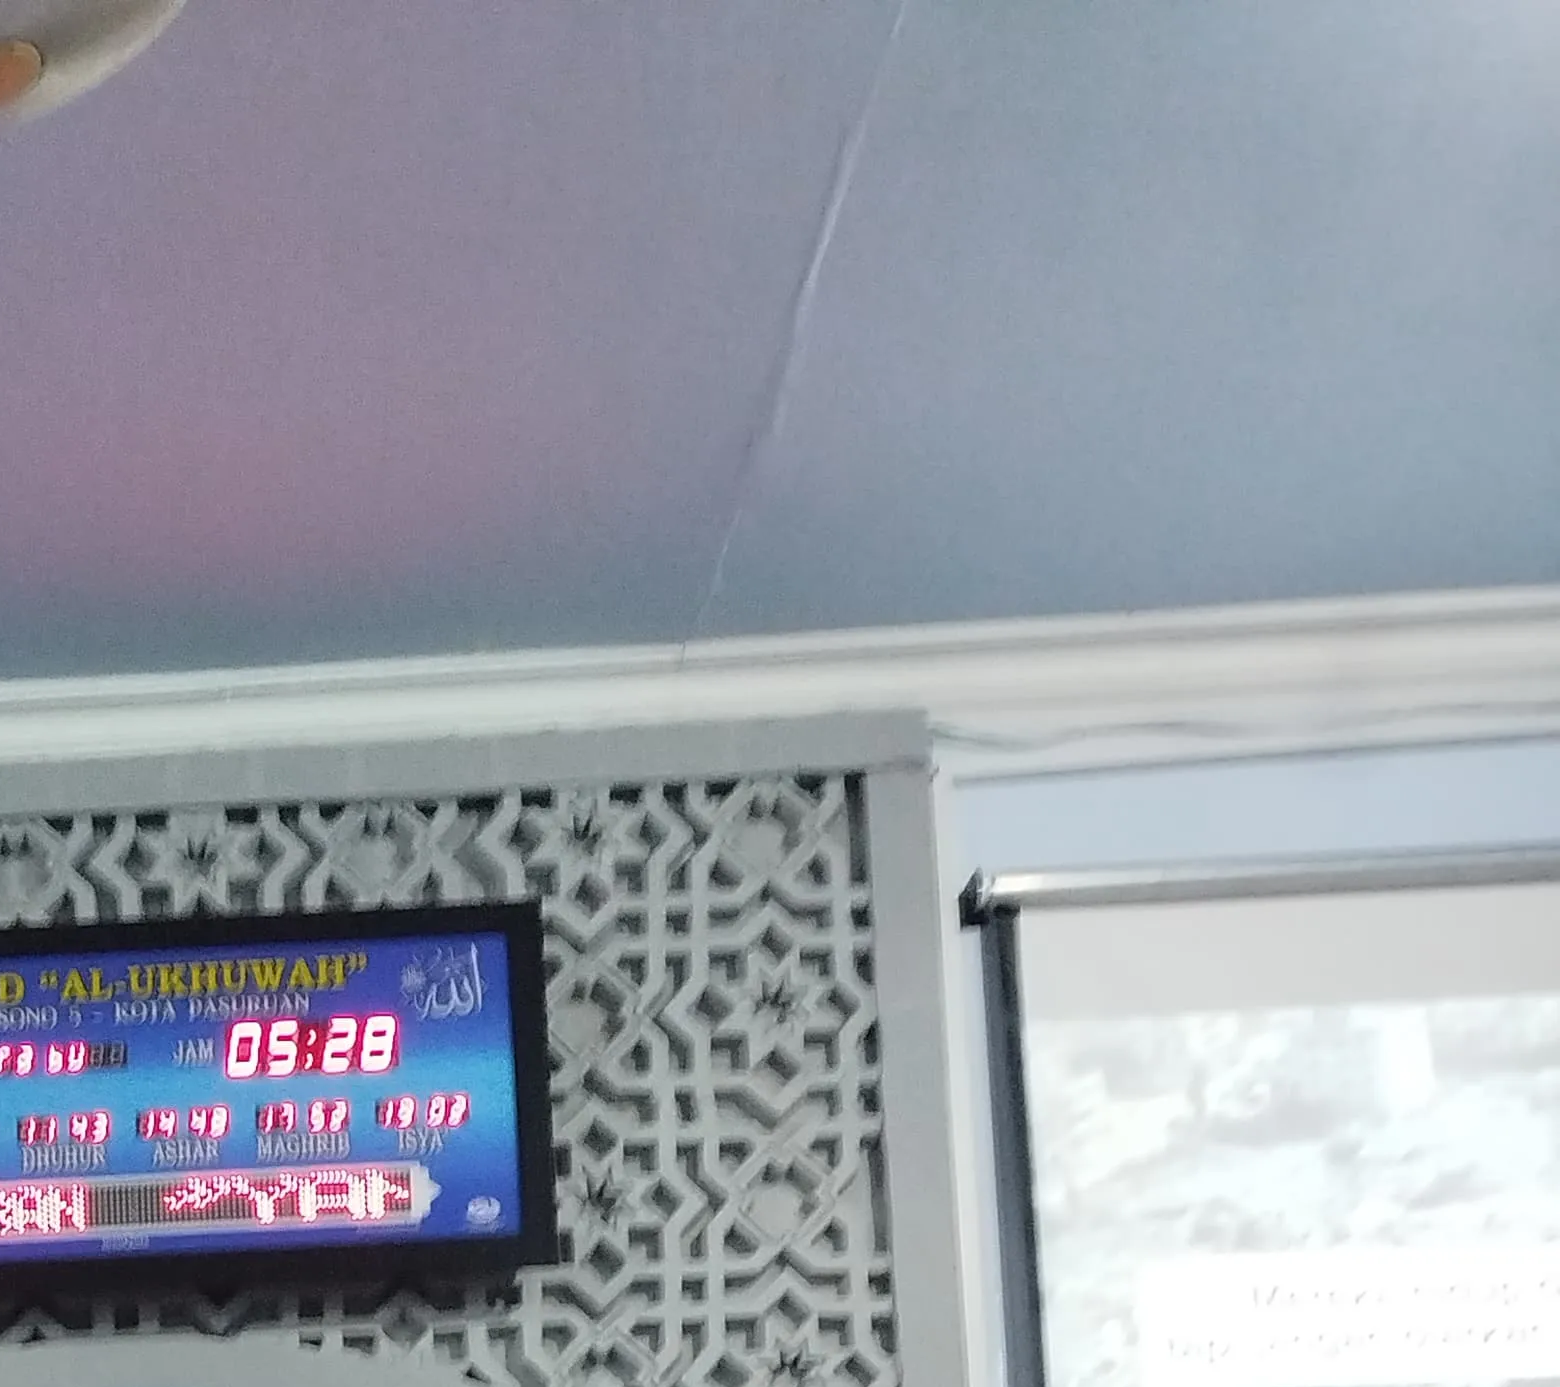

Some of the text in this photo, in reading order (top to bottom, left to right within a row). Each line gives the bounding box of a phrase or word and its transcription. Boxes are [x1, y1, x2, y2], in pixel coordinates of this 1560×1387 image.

[114, 998, 176, 1024] KOTA
[188, 991, 310, 1021] PASURUAN
[171, 1038, 214, 1066] JAM
[225, 1014, 399, 1079] 05:28
[20, 1142, 107, 1175] DHUHUR
[152, 1138, 220, 1168] ASHAR
[256, 1130, 351, 1161] MAGHRIB
